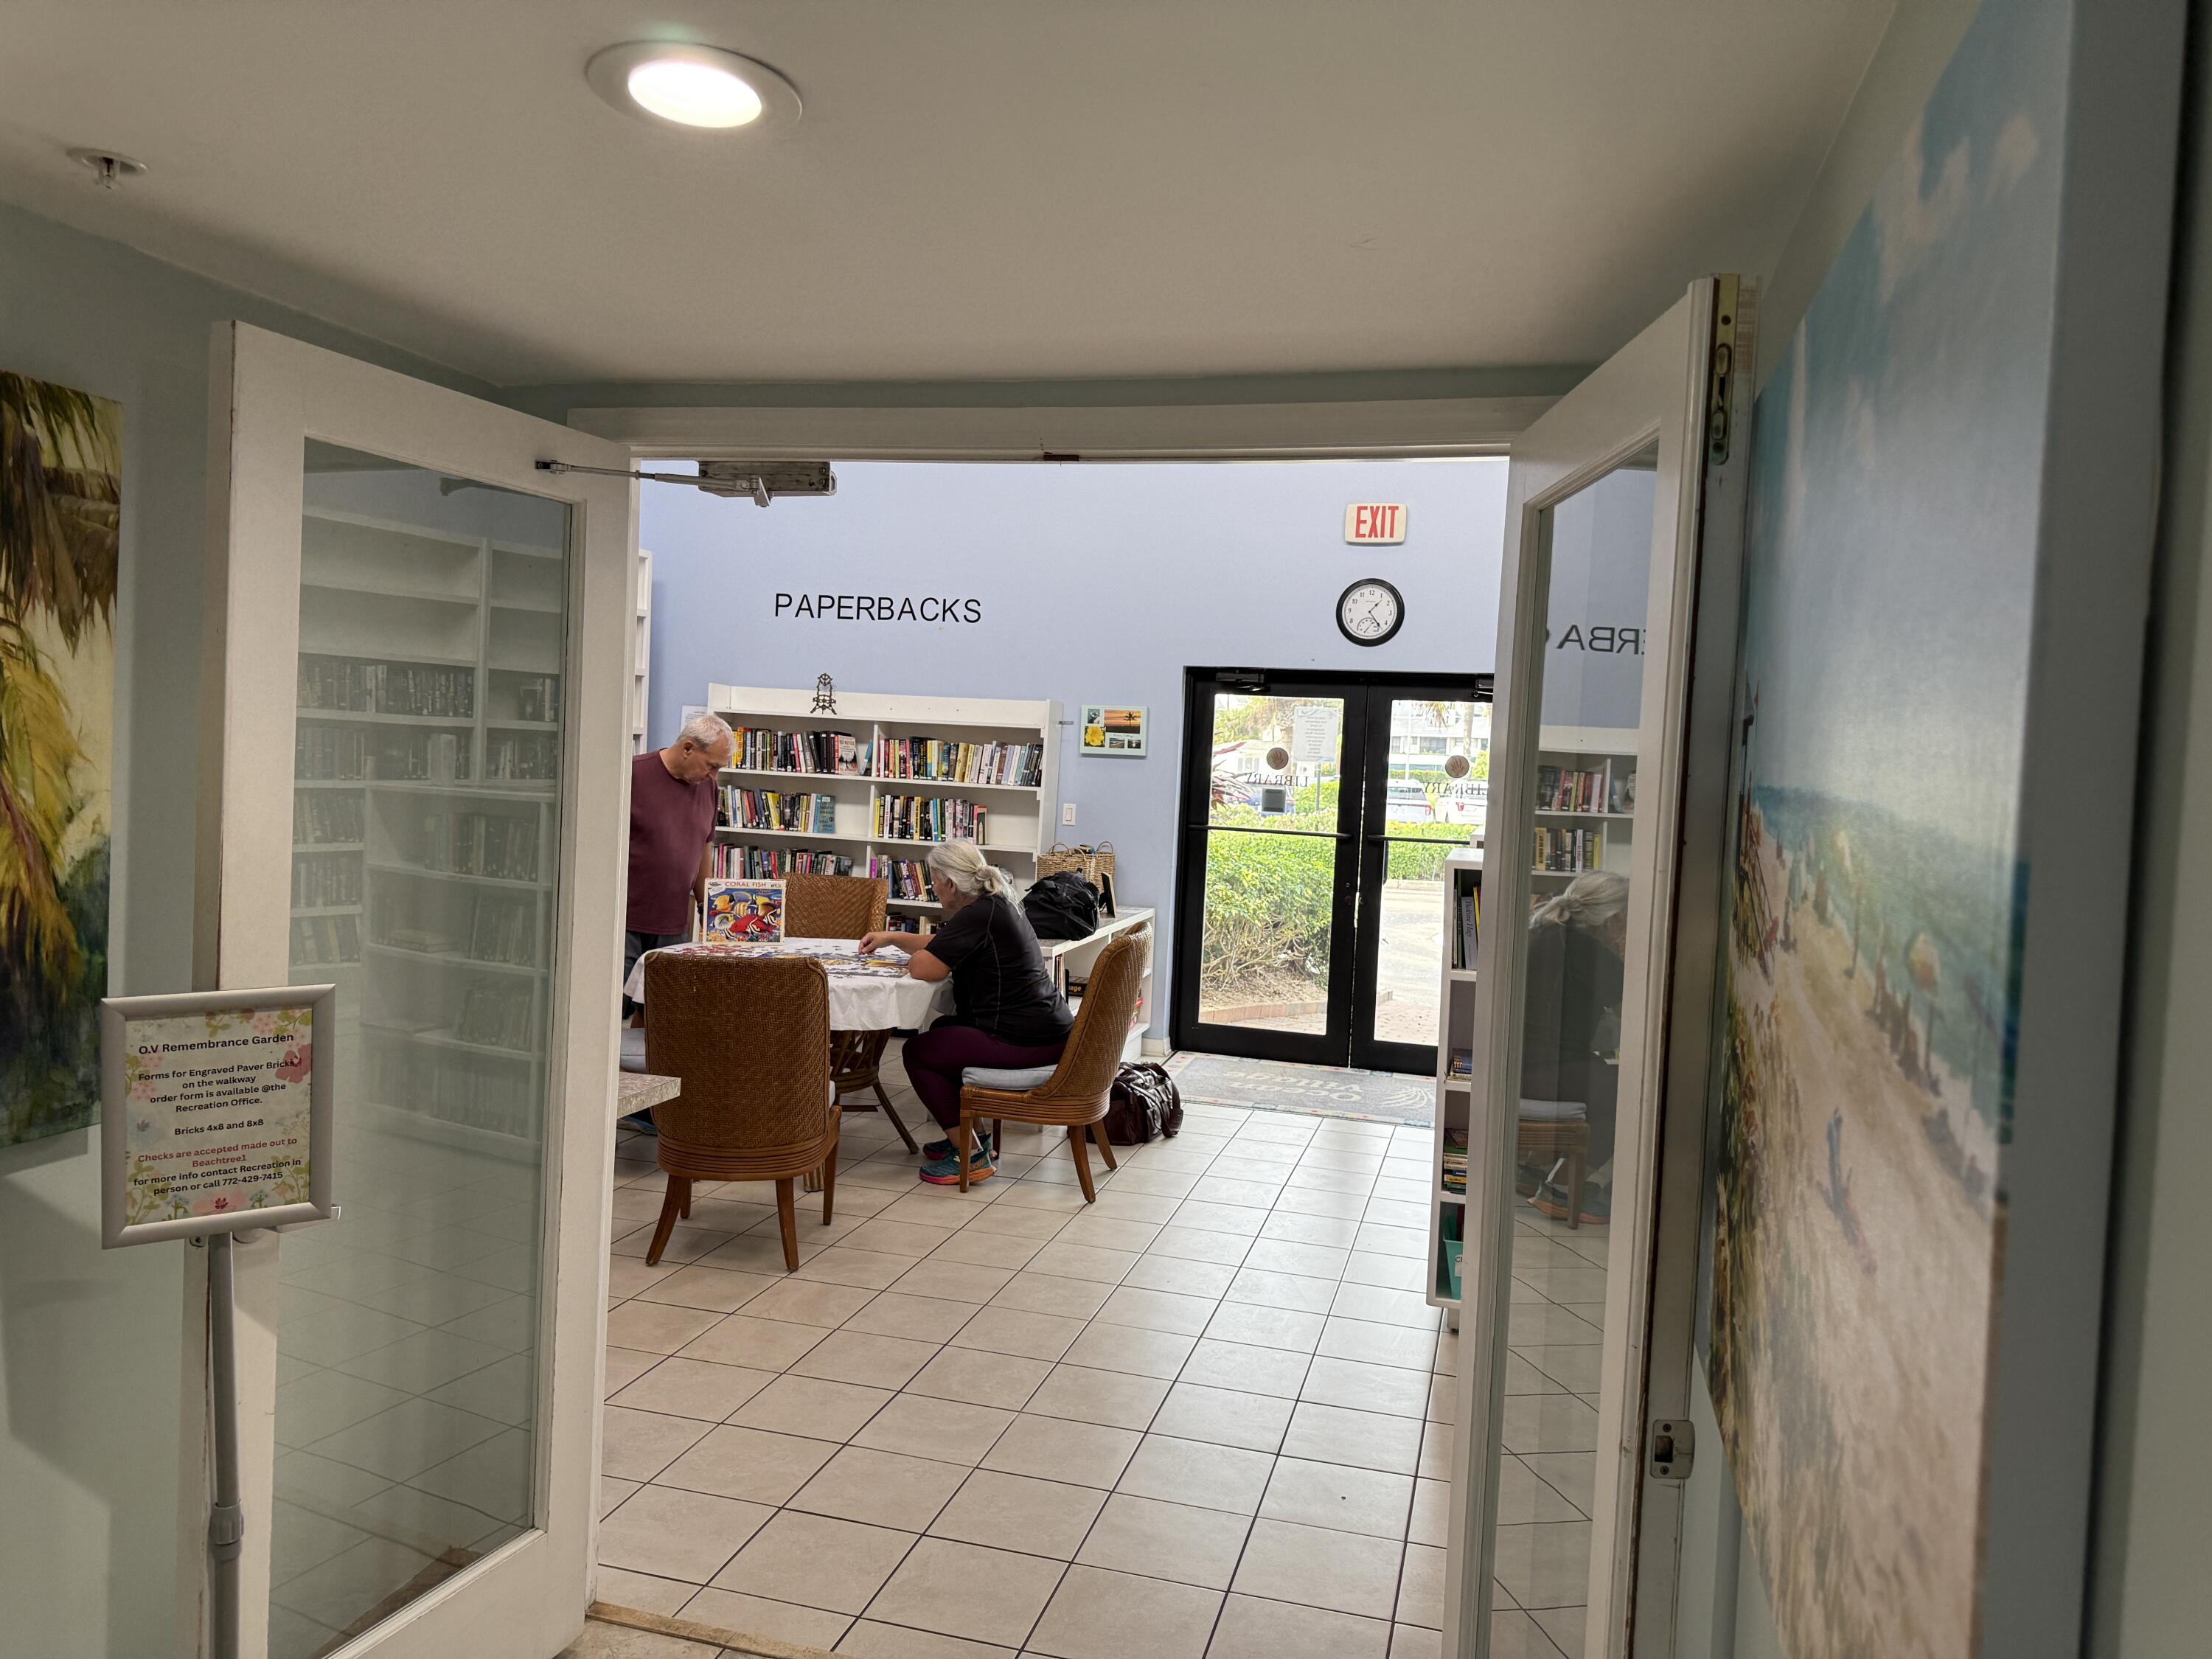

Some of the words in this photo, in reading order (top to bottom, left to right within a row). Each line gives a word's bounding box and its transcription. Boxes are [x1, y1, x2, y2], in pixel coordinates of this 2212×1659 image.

[1355, 506, 1399, 538] EXIT
[775, 593, 981, 623] PAPERBACKS
[139, 1045, 159, 1054] O.V
[162, 1038, 249, 1053] Remembrance
[251, 1034, 294, 1045] Garden
[138, 1072, 170, 1081] Forms
[172, 1070, 187, 1078] for
[189, 1065, 234, 1077] Engraved
[237, 1063, 265, 1072] Paver
[266, 1058, 296, 1069] Bricks
[197, 1079, 213, 1088] the
[215, 1076, 257, 1085] walkway
[1224, 1071, 1360, 1091] Village
[1230, 1081, 1362, 1101] Ocean
[150, 1094, 178, 1103] order
[180, 1091, 204, 1100] form
[206, 1090, 214, 1098] is
[216, 1085, 260, 1097] available
[261, 1083, 286, 1093] @the
[176, 1100, 229, 1113] Recreation
[231, 1097, 262, 1106] Office.
[175, 1127, 205, 1135] Bricks
[226, 1121, 244, 1130] and
[246, 1119, 264, 1127] 8x8
[138, 1152, 174, 1163] Checks
[176, 1150, 192, 1158] are
[194, 1144, 239, 1156] accepted
[241, 1141, 268, 1151] made
[192, 1155, 247, 1167] Beachtree1
[133, 1178, 149, 1186] for
[150, 1175, 177, 1183] more
[179, 1172, 198, 1180] info
[201, 1167, 238, 1178] contact
[240, 1160, 291, 1173] Recreation
[153, 1185, 188, 1196] person
[203, 1179, 220, 1189] call
[222, 1172, 283, 1186] 772-429-7415
